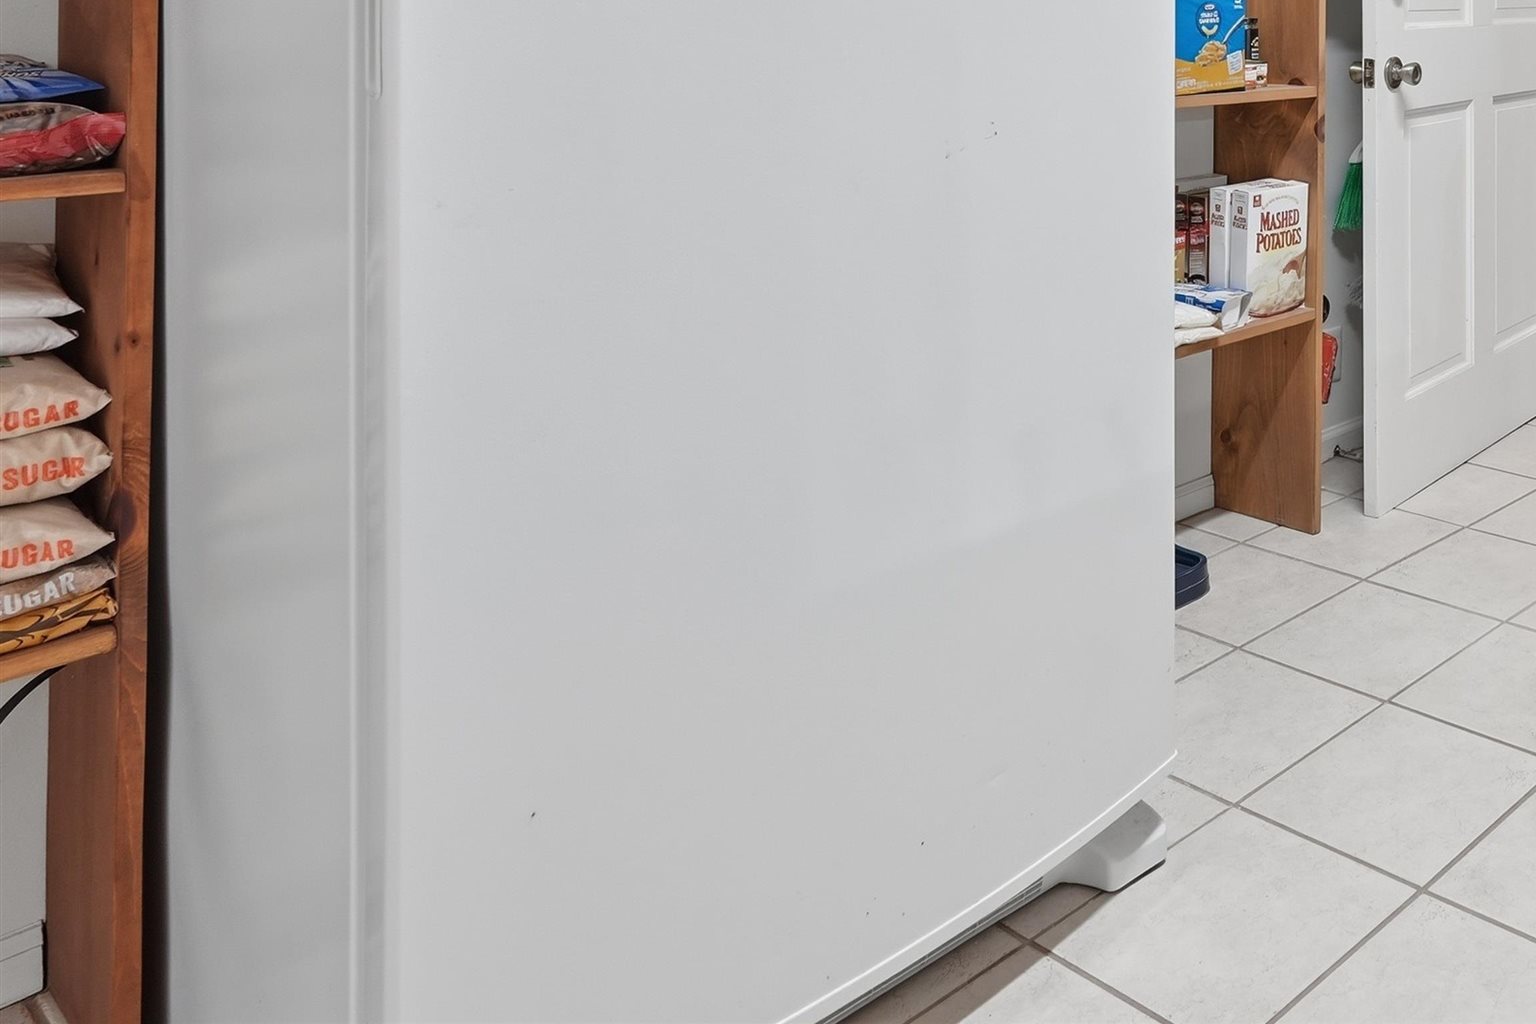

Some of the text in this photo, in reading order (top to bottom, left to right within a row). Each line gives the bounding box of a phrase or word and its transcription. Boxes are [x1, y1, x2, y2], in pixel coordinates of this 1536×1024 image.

[1259, 208, 1300, 232] MASHED
[1255, 227, 1302, 253] POTATOES
[0, 400, 79, 432] UGAR
[2, 456, 85, 491] SUGAR
[0, 539, 74, 569] UGAR
[0, 571, 75, 616] UGAR
